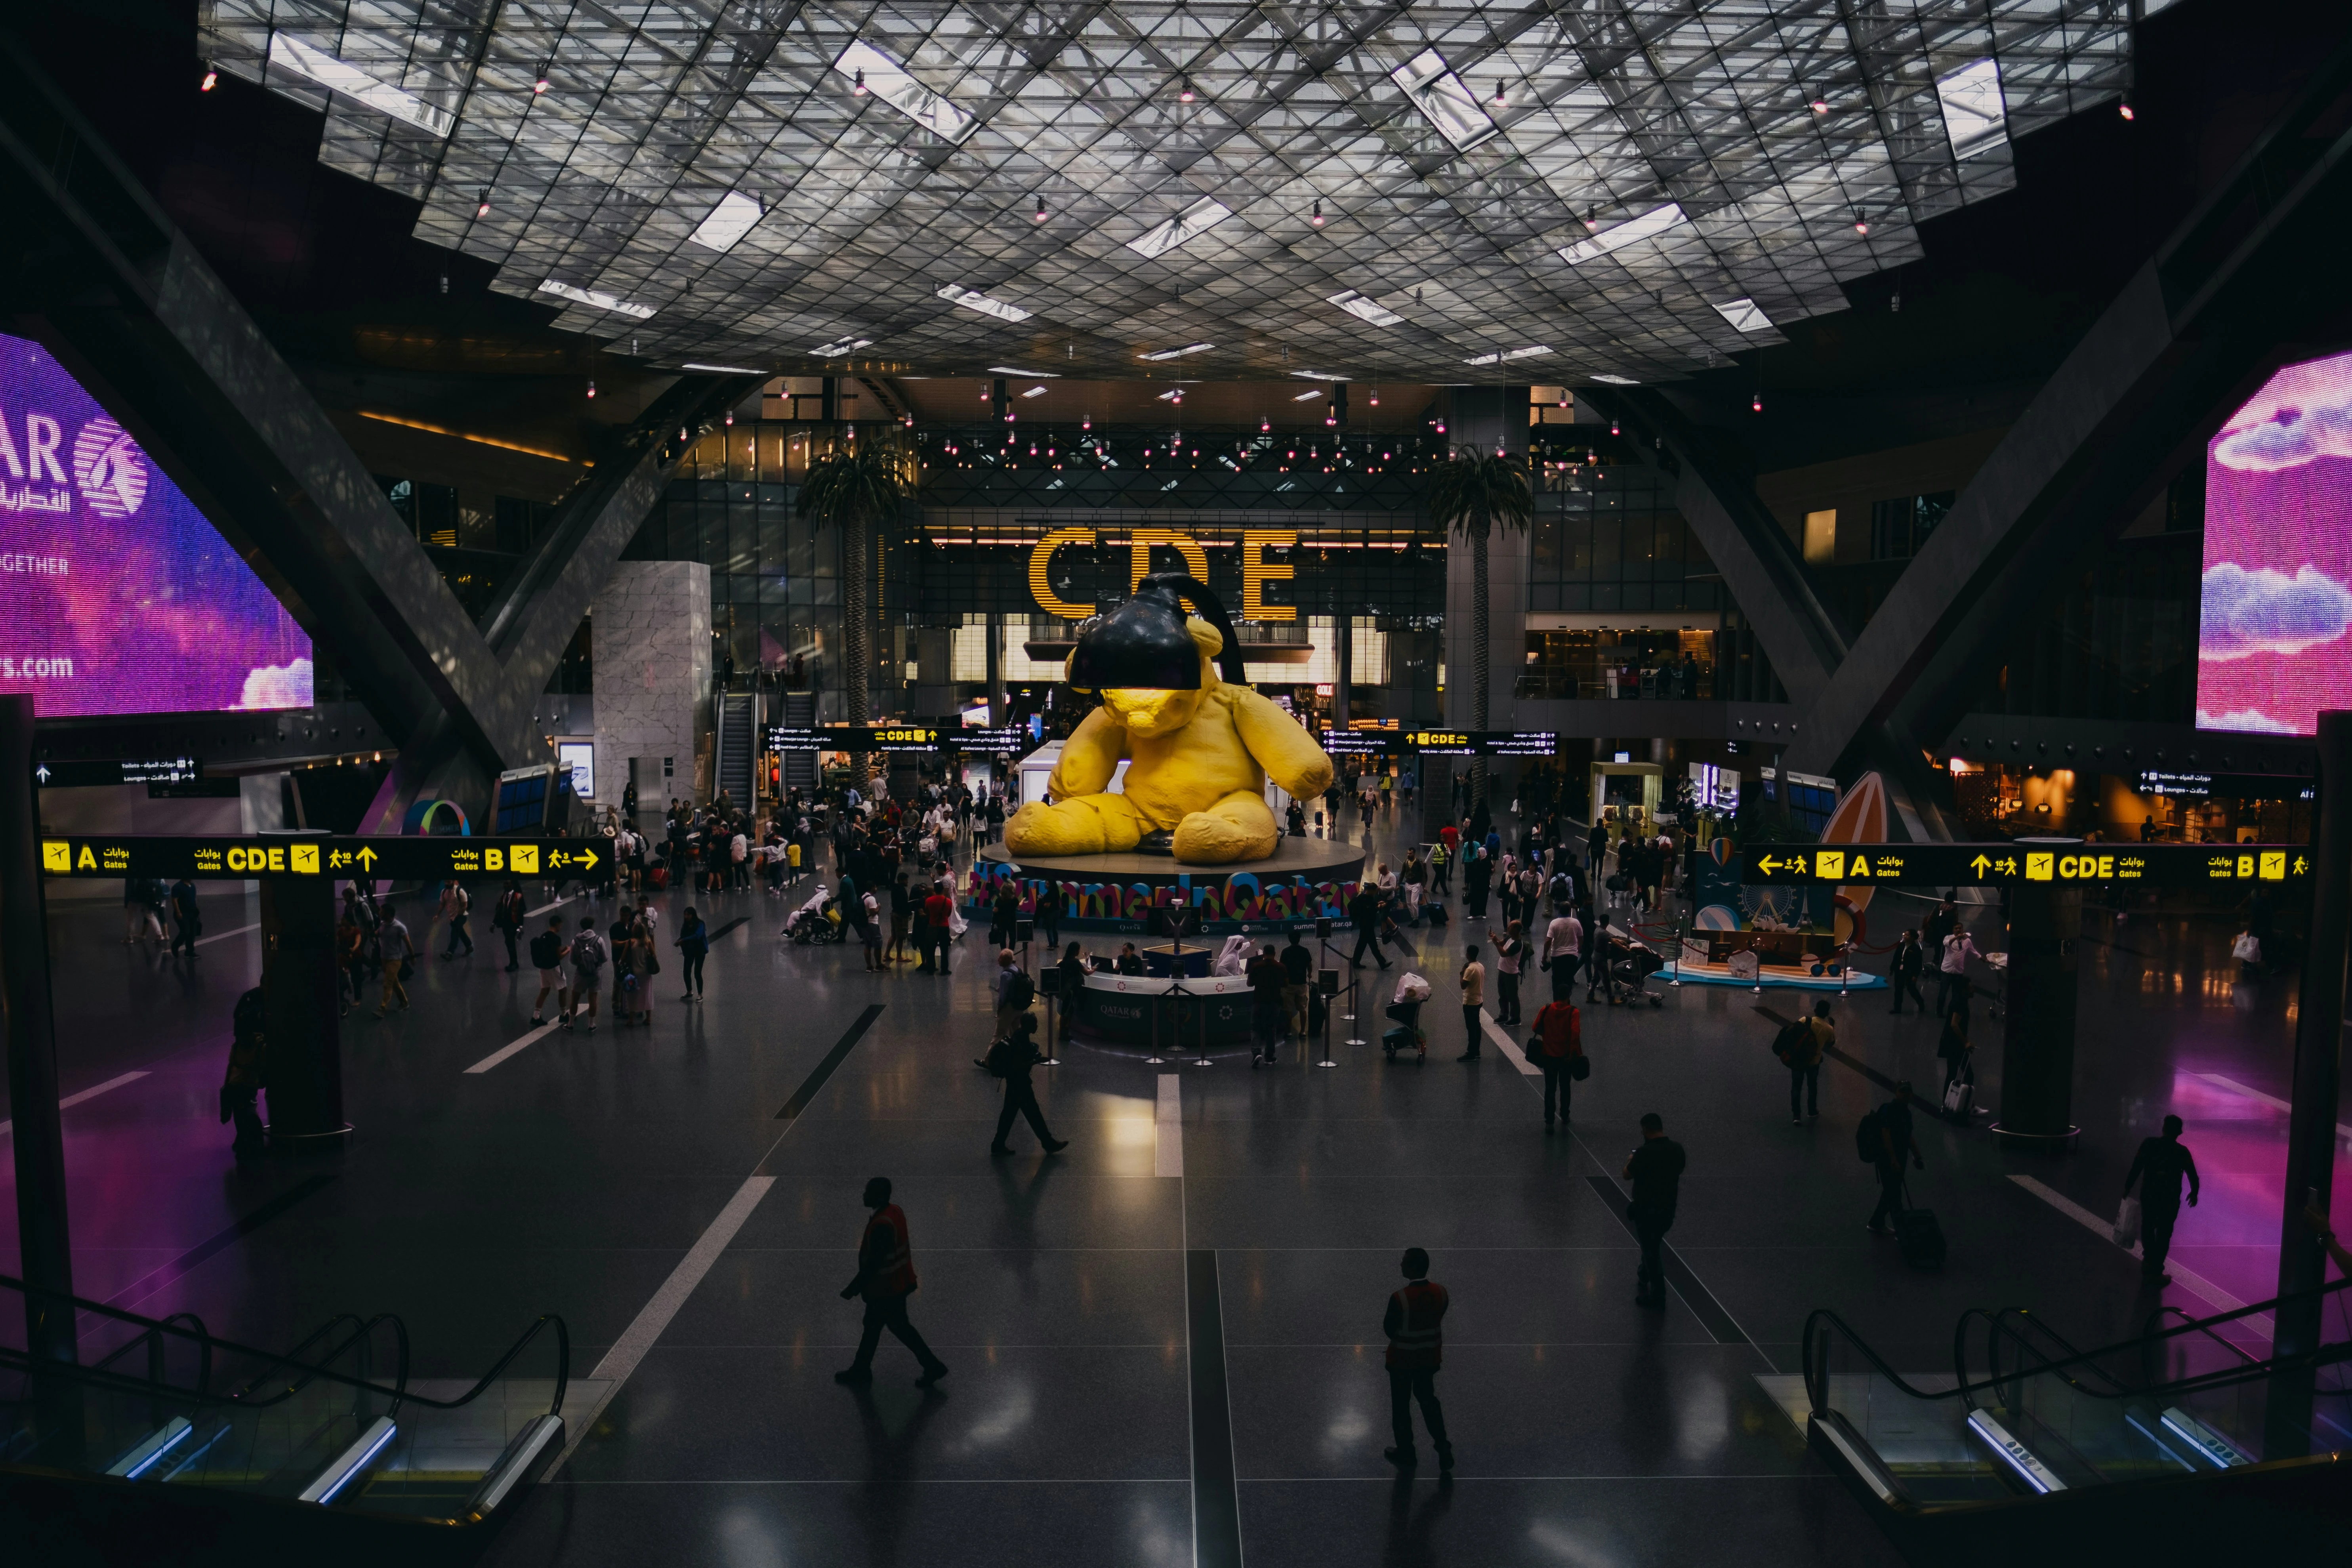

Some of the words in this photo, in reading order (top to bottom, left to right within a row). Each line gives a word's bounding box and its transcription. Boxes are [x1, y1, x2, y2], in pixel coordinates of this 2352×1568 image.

[0, 555, 69, 574] GETHER
[1029, 527, 1297, 621] CDE
[0, 658, 74, 677] s.com
[887, 731, 912, 740] CDE
[1431, 734, 1455, 744] CDE
[78, 846, 97, 869] A
[104, 847, 129, 858] بوابات
[195, 849, 220, 859] بوابات
[452, 849, 478, 860] بوابات
[227, 848, 284, 870] CDE
[485, 849, 504, 870] B
[1878, 856, 1903, 866] بوابات
[2120, 857, 2144, 867] بوابات
[2208, 857, 2232, 867] بوابات
[1850, 856, 1869, 876] A
[2060, 856, 2114, 877] CDE
[2238, 856, 2253, 877] B
[1294, 920, 1352, 930] summatar.qa
[1101, 1005, 1129, 1016] QATAR
